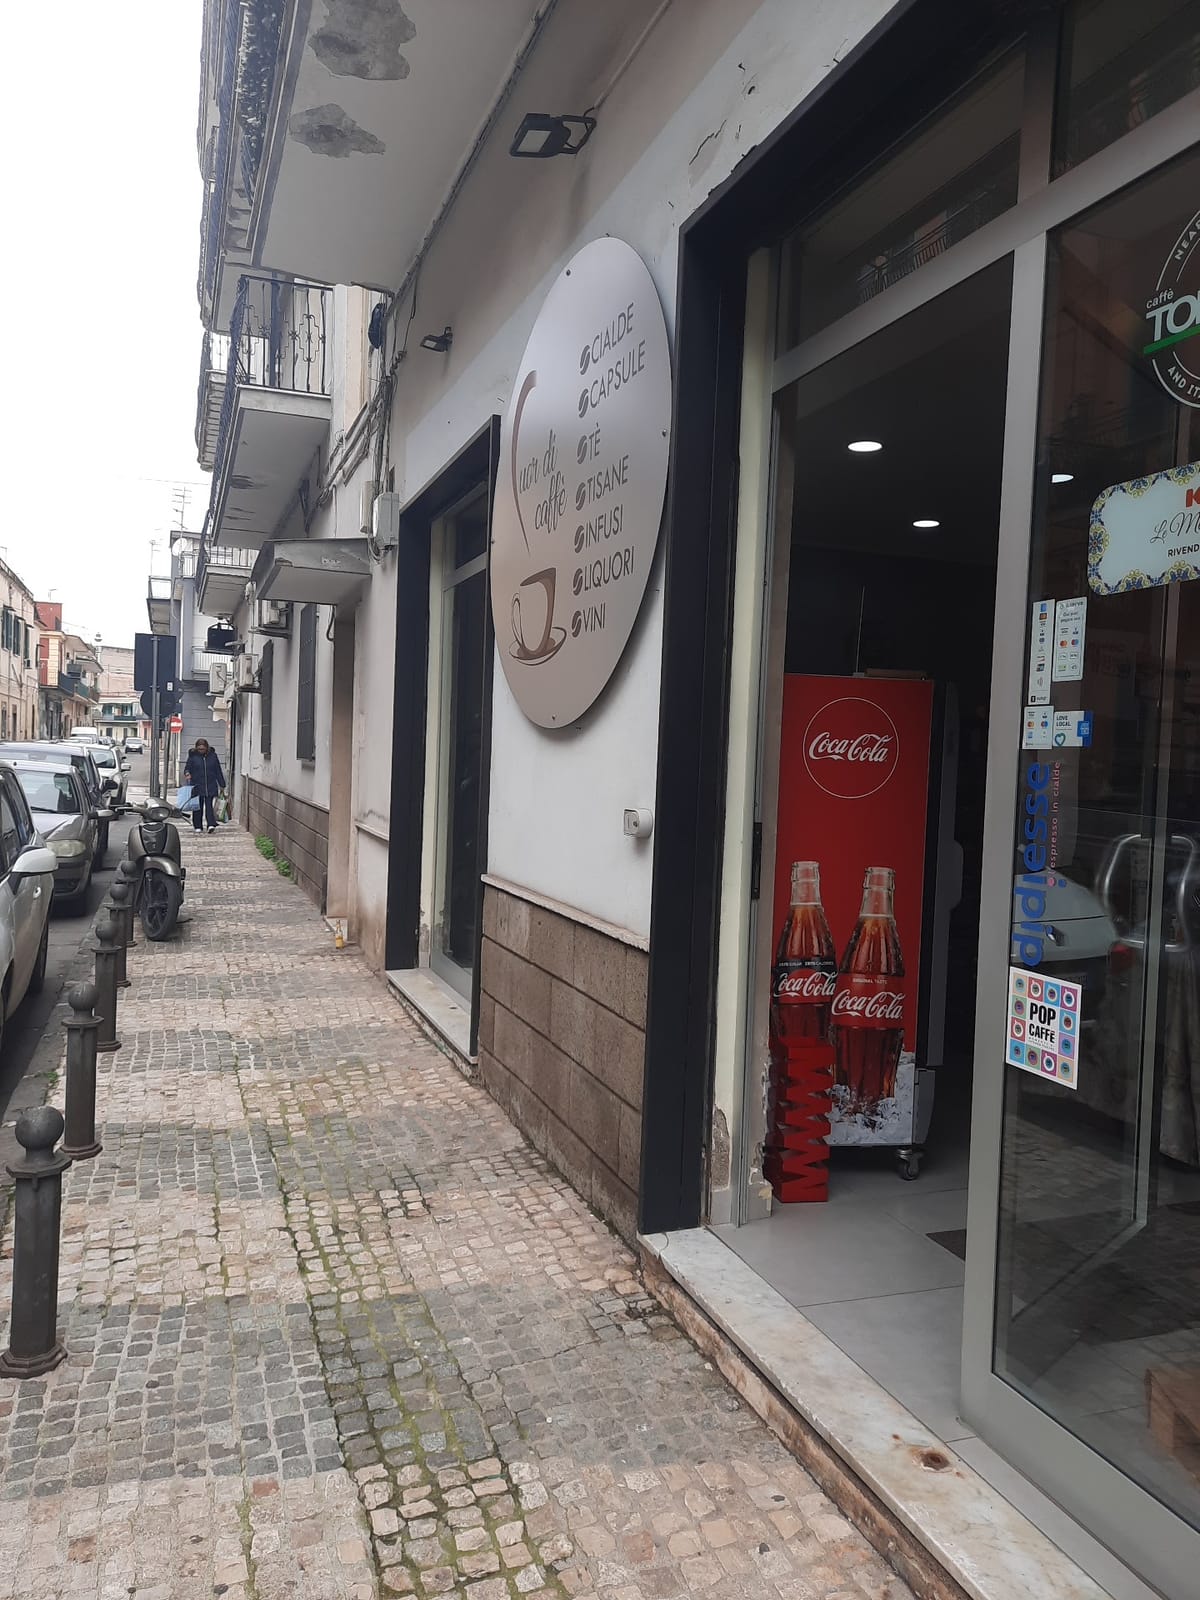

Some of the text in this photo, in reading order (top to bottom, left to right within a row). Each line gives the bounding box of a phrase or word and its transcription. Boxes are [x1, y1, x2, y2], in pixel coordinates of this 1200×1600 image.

[1146, 288, 1174, 309] caffè
[591, 302, 634, 364] CIALDE
[589, 340, 646, 409] CAPSULE
[1167, 366, 1200, 399] AND IT
[543, 429, 558, 477] di
[588, 422, 601, 460] TÈ
[587, 455, 630, 506] TISANE
[535, 471, 567, 534] caffè
[584, 504, 624, 549] INFUSI
[1168, 543, 1200, 557] RIVEND
[584, 546, 635, 592] LIQUORI
[583, 602, 607, 633] VINI
[808, 731, 894, 762] Coca-Cola
[1050, 760, 1061, 797] cialde
[1049, 801, 1059, 814] in
[1012, 761, 1060, 967] didiesse
[773, 971, 838, 998] Coca-Cola
[831, 989, 906, 1020] Coca-Cola
[1029, 1002, 1056, 1026] POP
